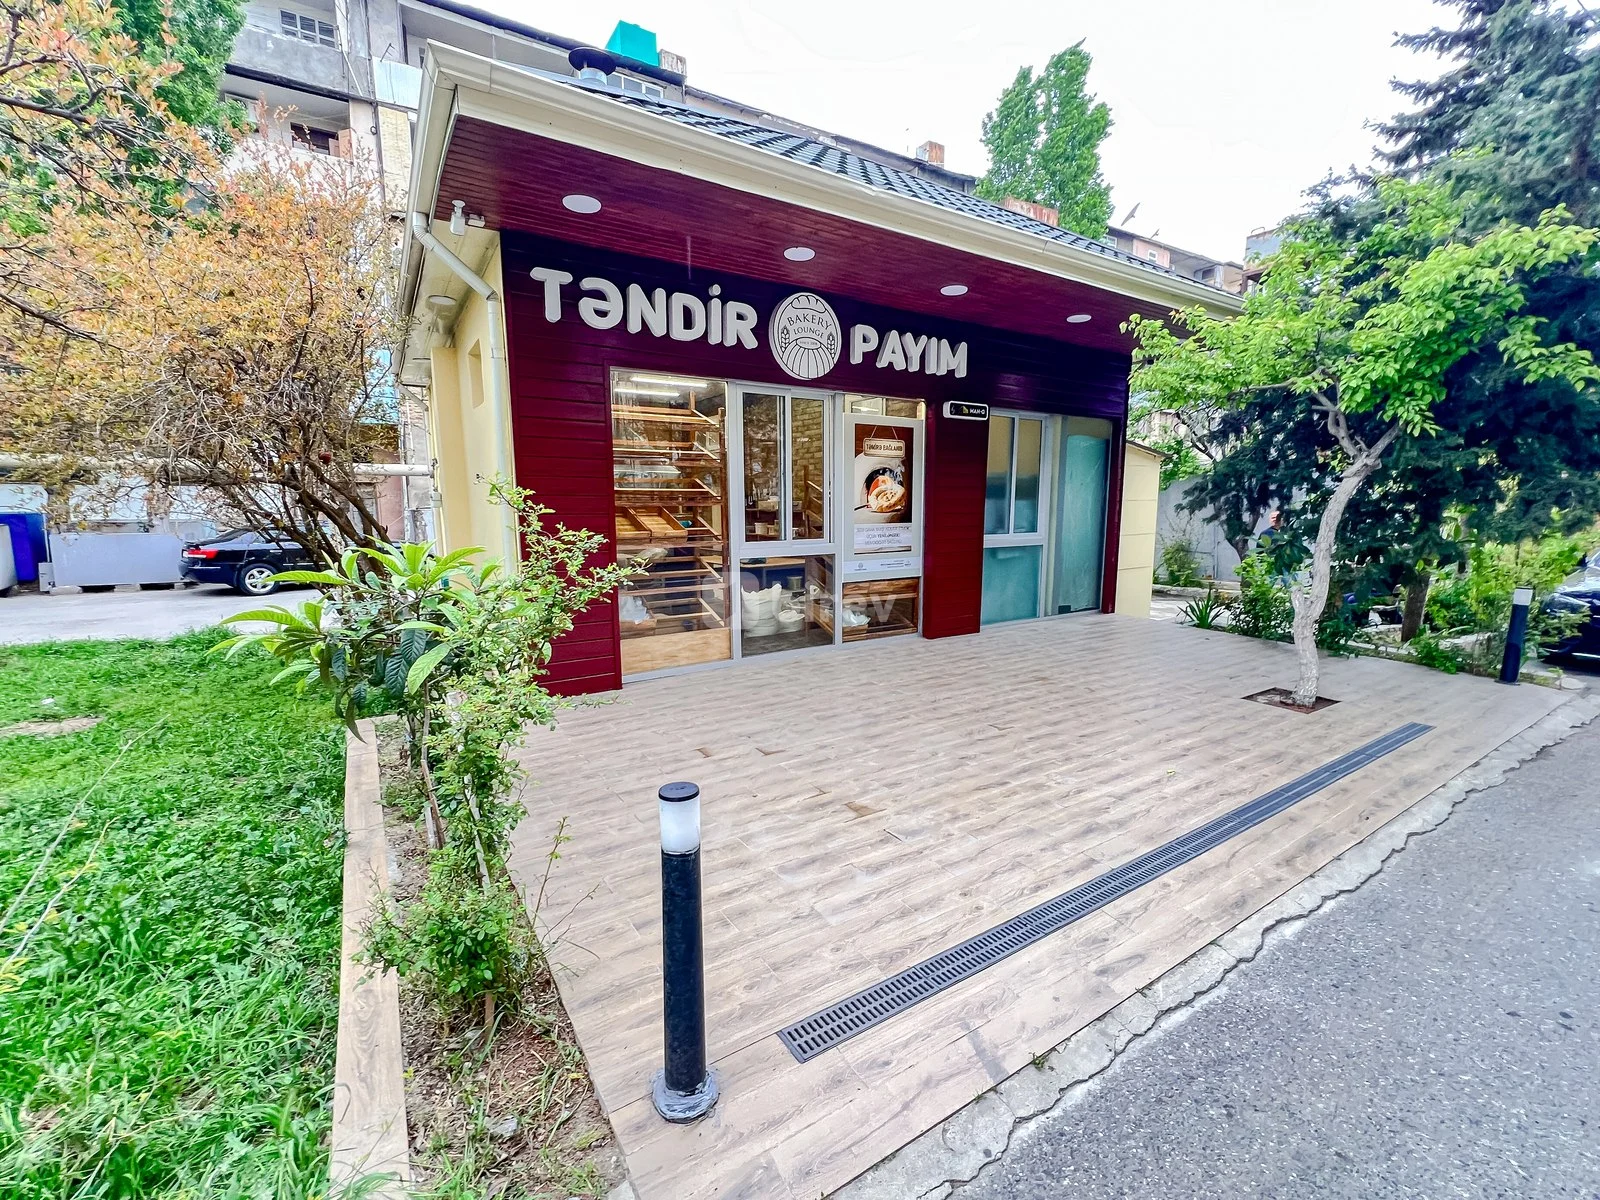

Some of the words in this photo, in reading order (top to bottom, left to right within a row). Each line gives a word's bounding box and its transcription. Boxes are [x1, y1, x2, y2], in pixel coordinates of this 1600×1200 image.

[529, 266, 759, 350] TƏNDİR
[850, 323, 968, 379] PAYIM
[787, 313, 832, 330] BAKERY
[793, 326, 824, 339] LOUNGE
